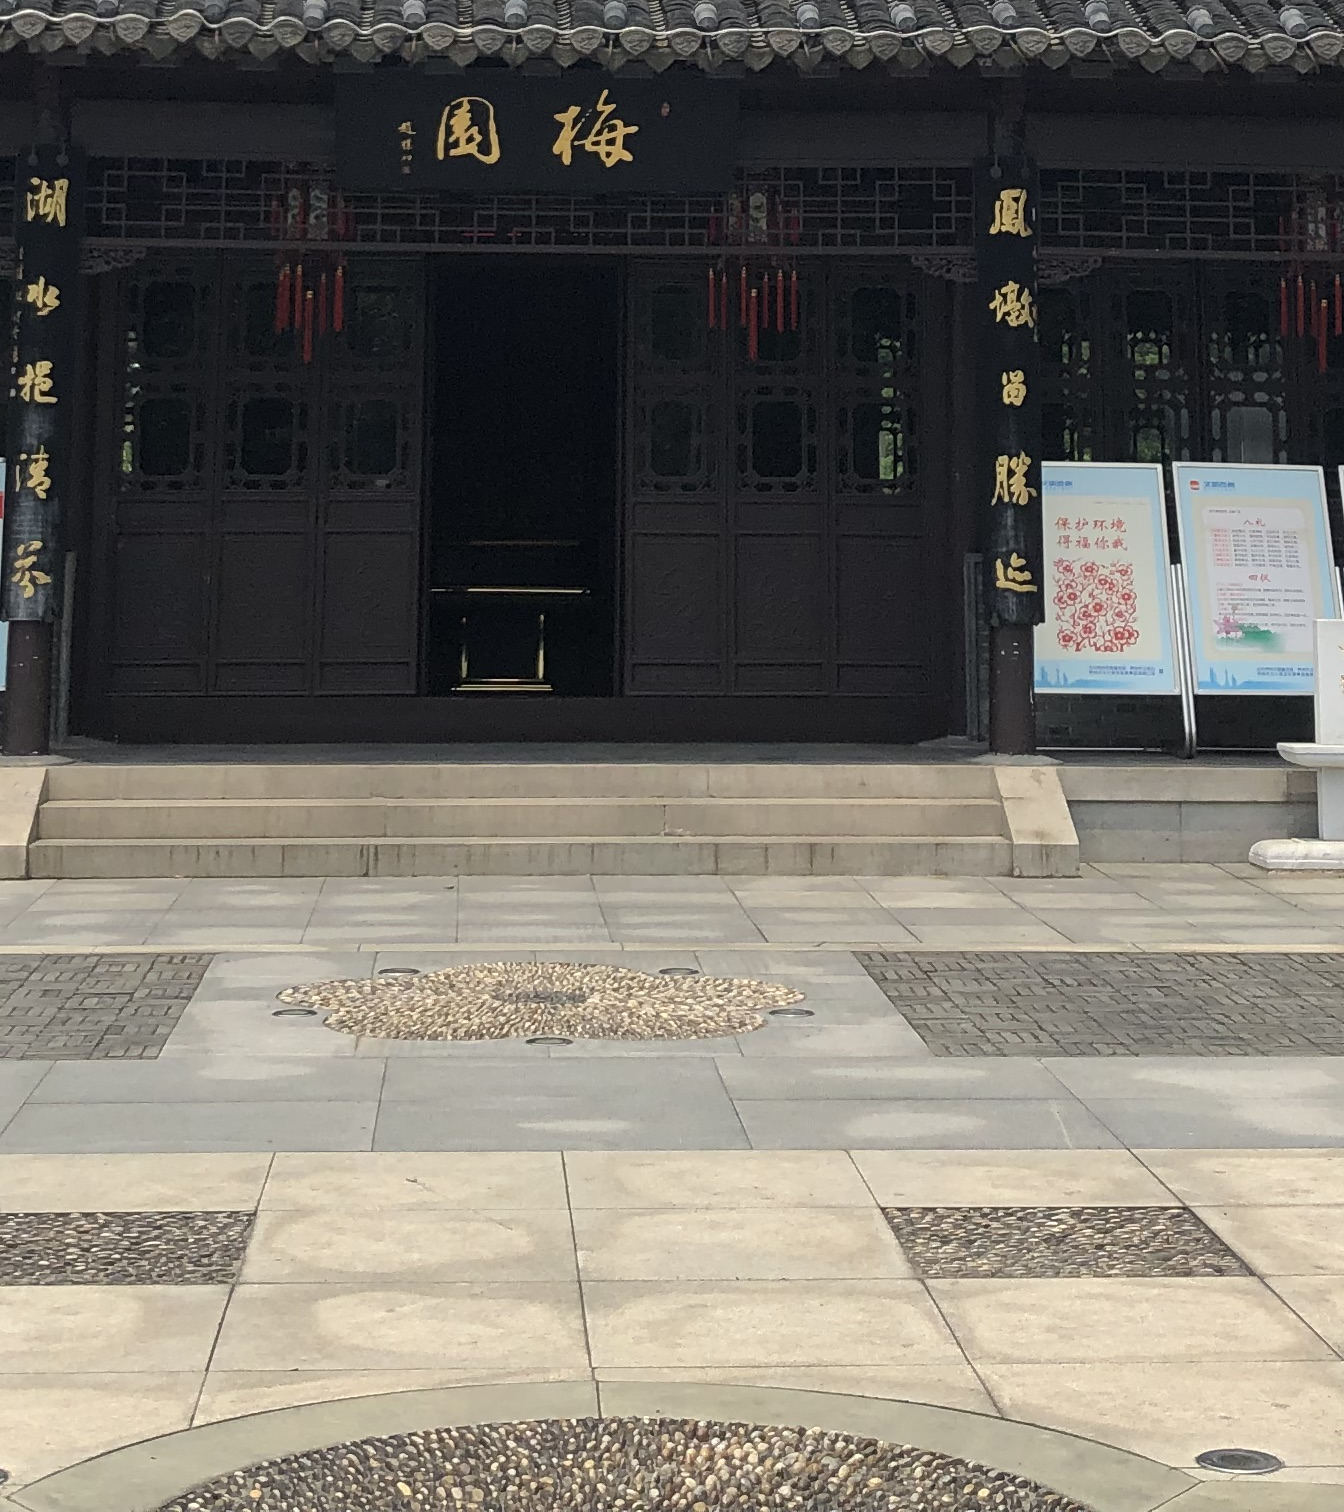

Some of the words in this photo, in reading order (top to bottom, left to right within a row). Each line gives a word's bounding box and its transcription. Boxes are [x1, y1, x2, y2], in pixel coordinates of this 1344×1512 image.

[1055, 516, 1128, 533] 保护环境
[1056, 534, 1129, 552] 得福你我
